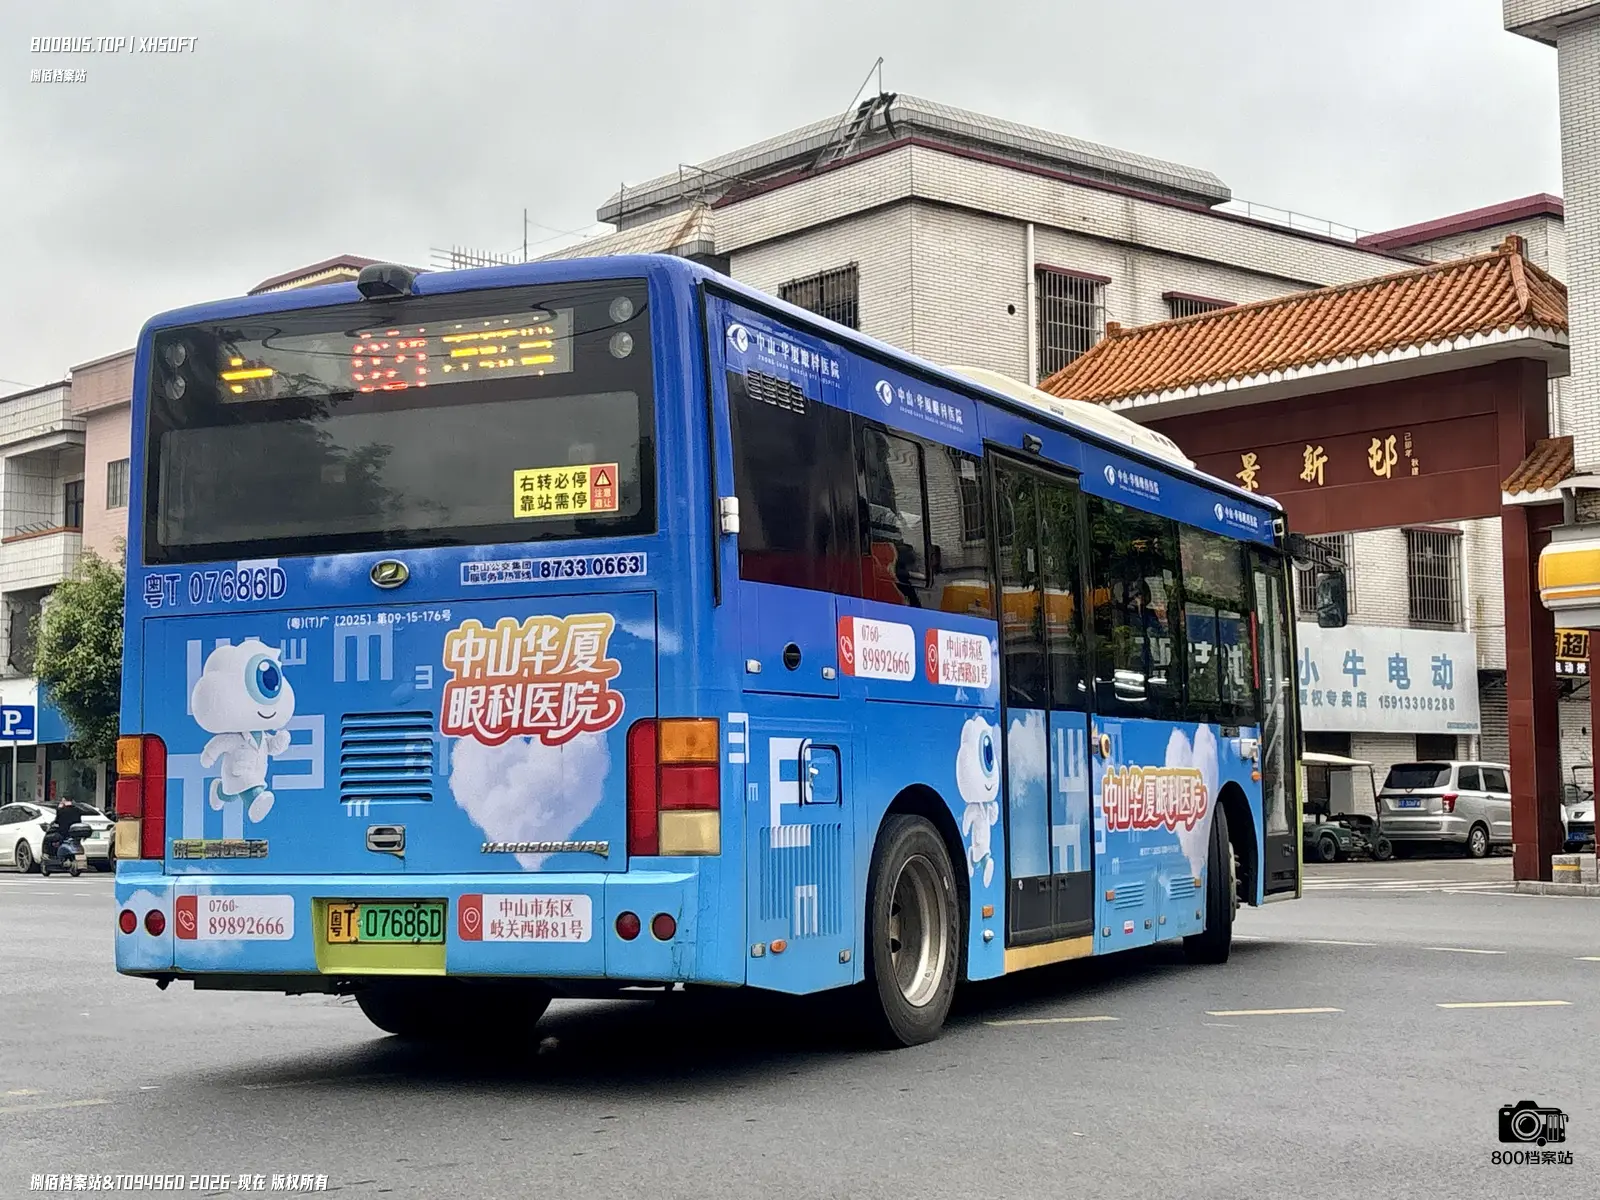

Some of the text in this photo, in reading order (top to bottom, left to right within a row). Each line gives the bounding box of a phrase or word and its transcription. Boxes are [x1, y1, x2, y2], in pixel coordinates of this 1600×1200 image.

[520, 471, 587, 492] 右转必停
[520, 491, 587, 512] 靠站需停
[540, 555, 641, 579] 8733 0663
[143, 567, 287, 608] 粤T 07686D
[449, 618, 614, 679] 中山华厦
[946, 636, 984, 662] 中山市东区
[862, 648, 910, 675] 89892666
[1299, 647, 1453, 691] 小牛电动
[447, 681, 617, 738] 眼科医院
[1378, 694, 1455, 711] 15913308288
[2, 710, 22, 735] P
[499, 898, 574, 918] 中山市东区
[209, 917, 284, 935] 89892666
[330, 909, 441, 937] 粤T 07686D
